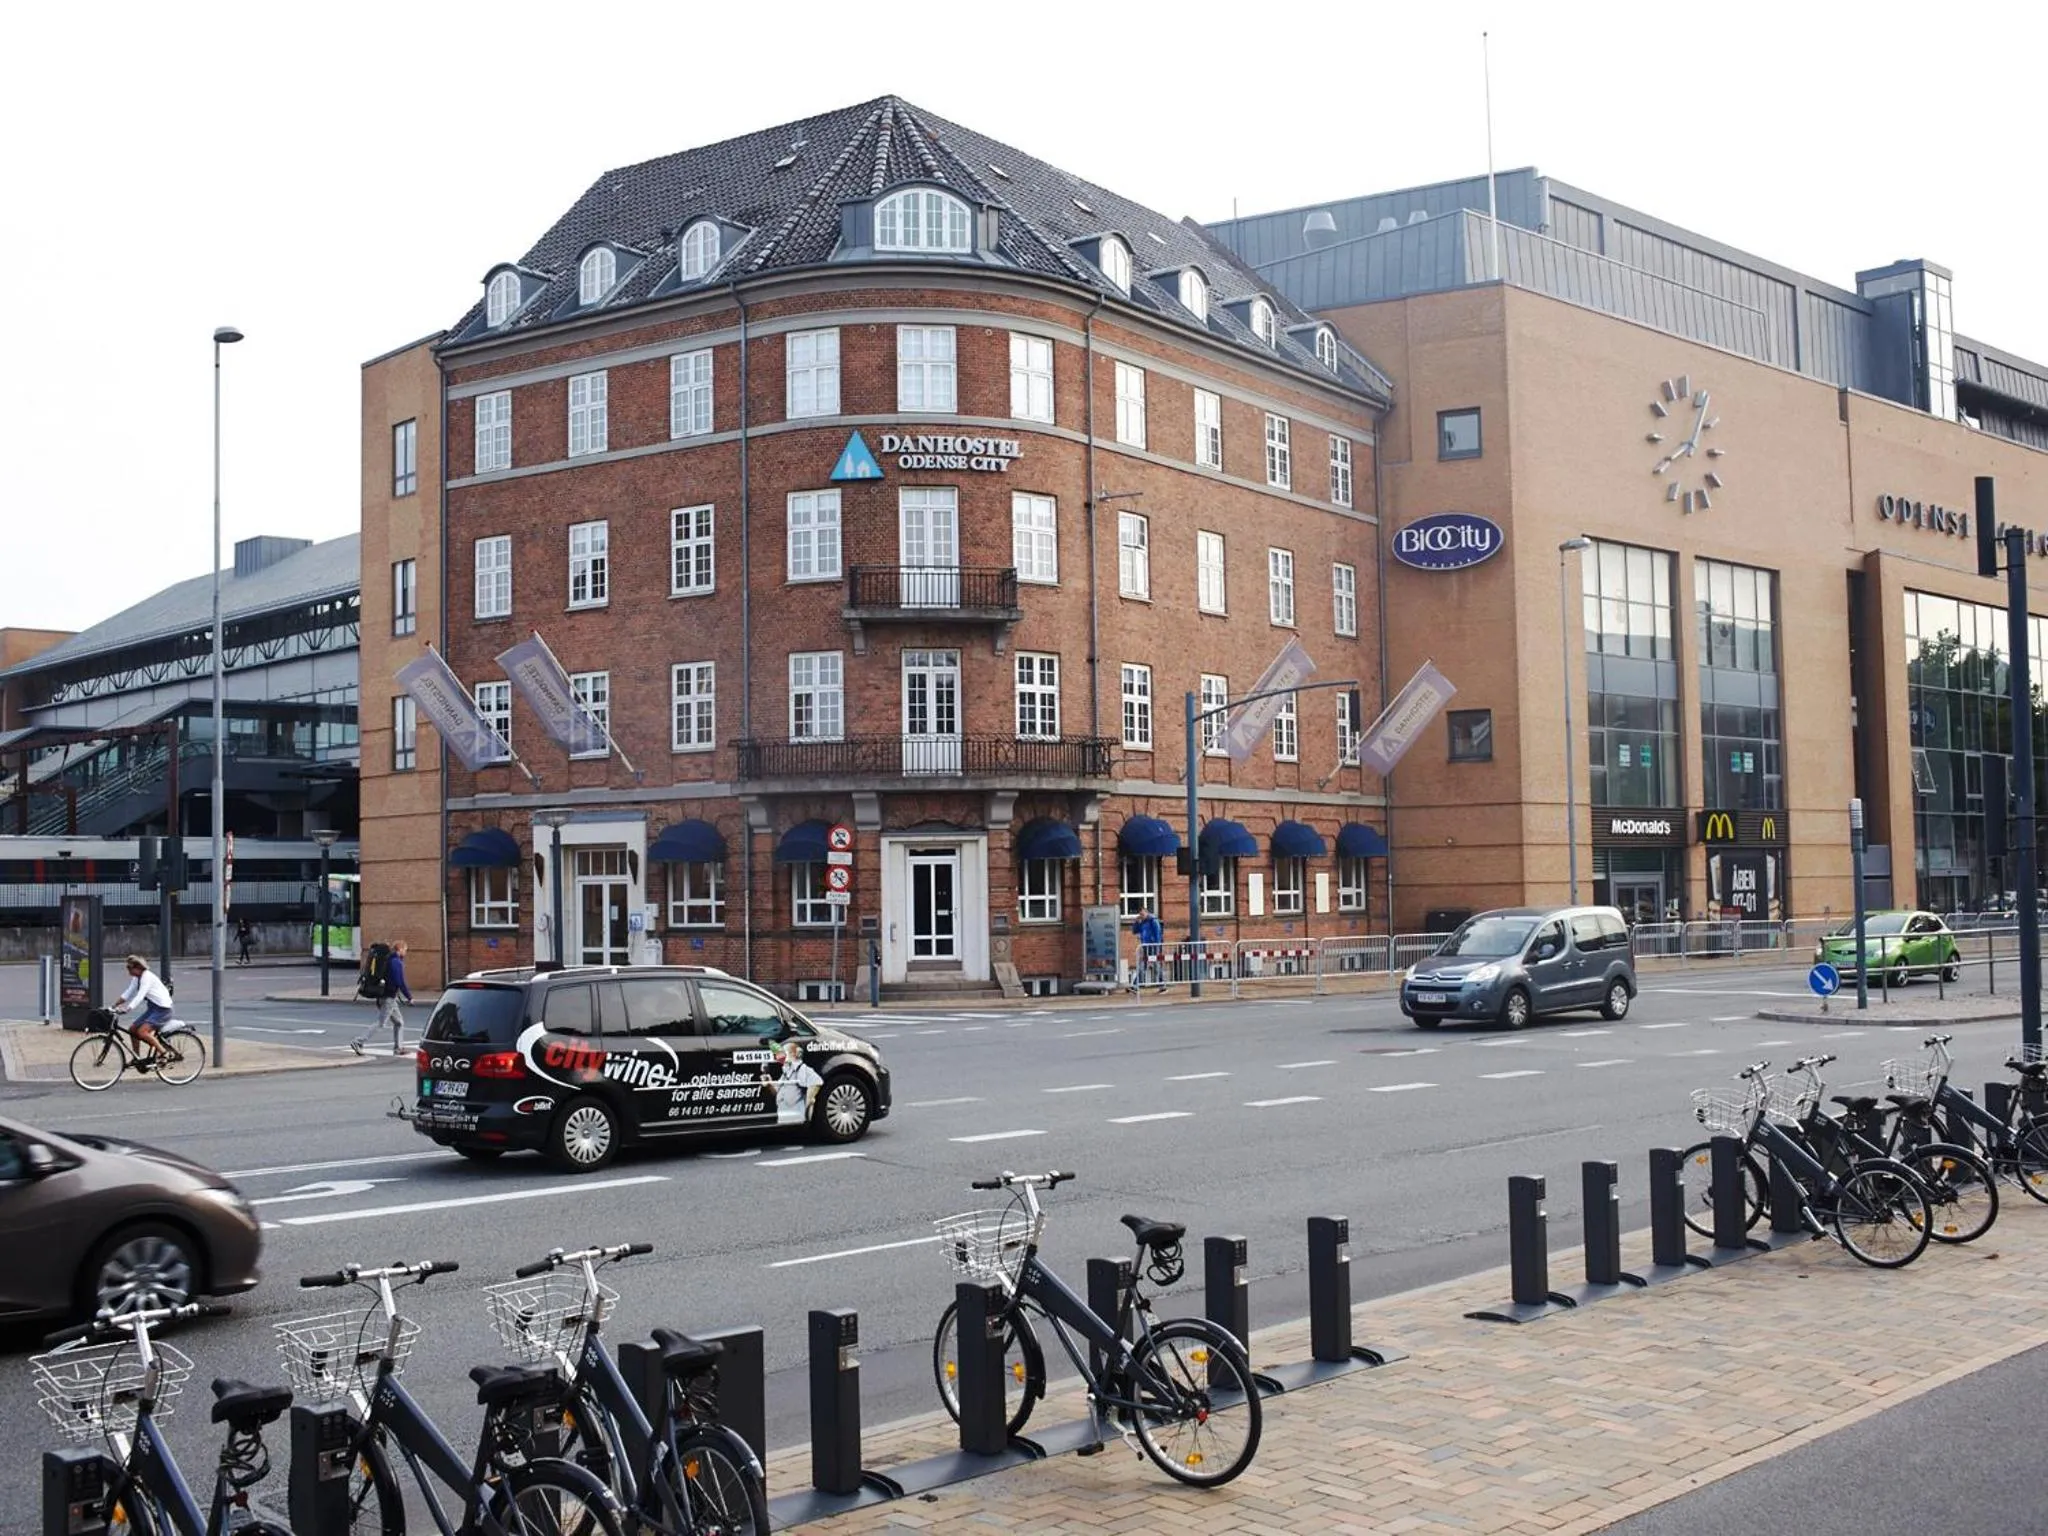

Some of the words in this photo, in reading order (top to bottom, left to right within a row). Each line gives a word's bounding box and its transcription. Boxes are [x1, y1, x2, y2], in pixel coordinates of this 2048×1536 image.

[880, 434, 1024, 458] DANHOSTEL
[899, 454, 967, 470] ODENSE
[970, 456, 1010, 472] CITY
[1611, 819, 1671, 835] McDonald's
[1732, 864, 1756, 890] ÅBEN
[672, 1089, 690, 1101] for
[692, 1088, 714, 1101] alle
[716, 1086, 762, 1099] sanser!
[681, 1106, 691, 1116] 14
[692, 1106, 702, 1115] 01
[705, 1105, 715, 1114] 10
[720, 1103, 731, 1114] 64
[732, 1103, 742, 1112] 41
[744, 1102, 753, 1112] 11
[753, 1102, 765, 1112] 03
